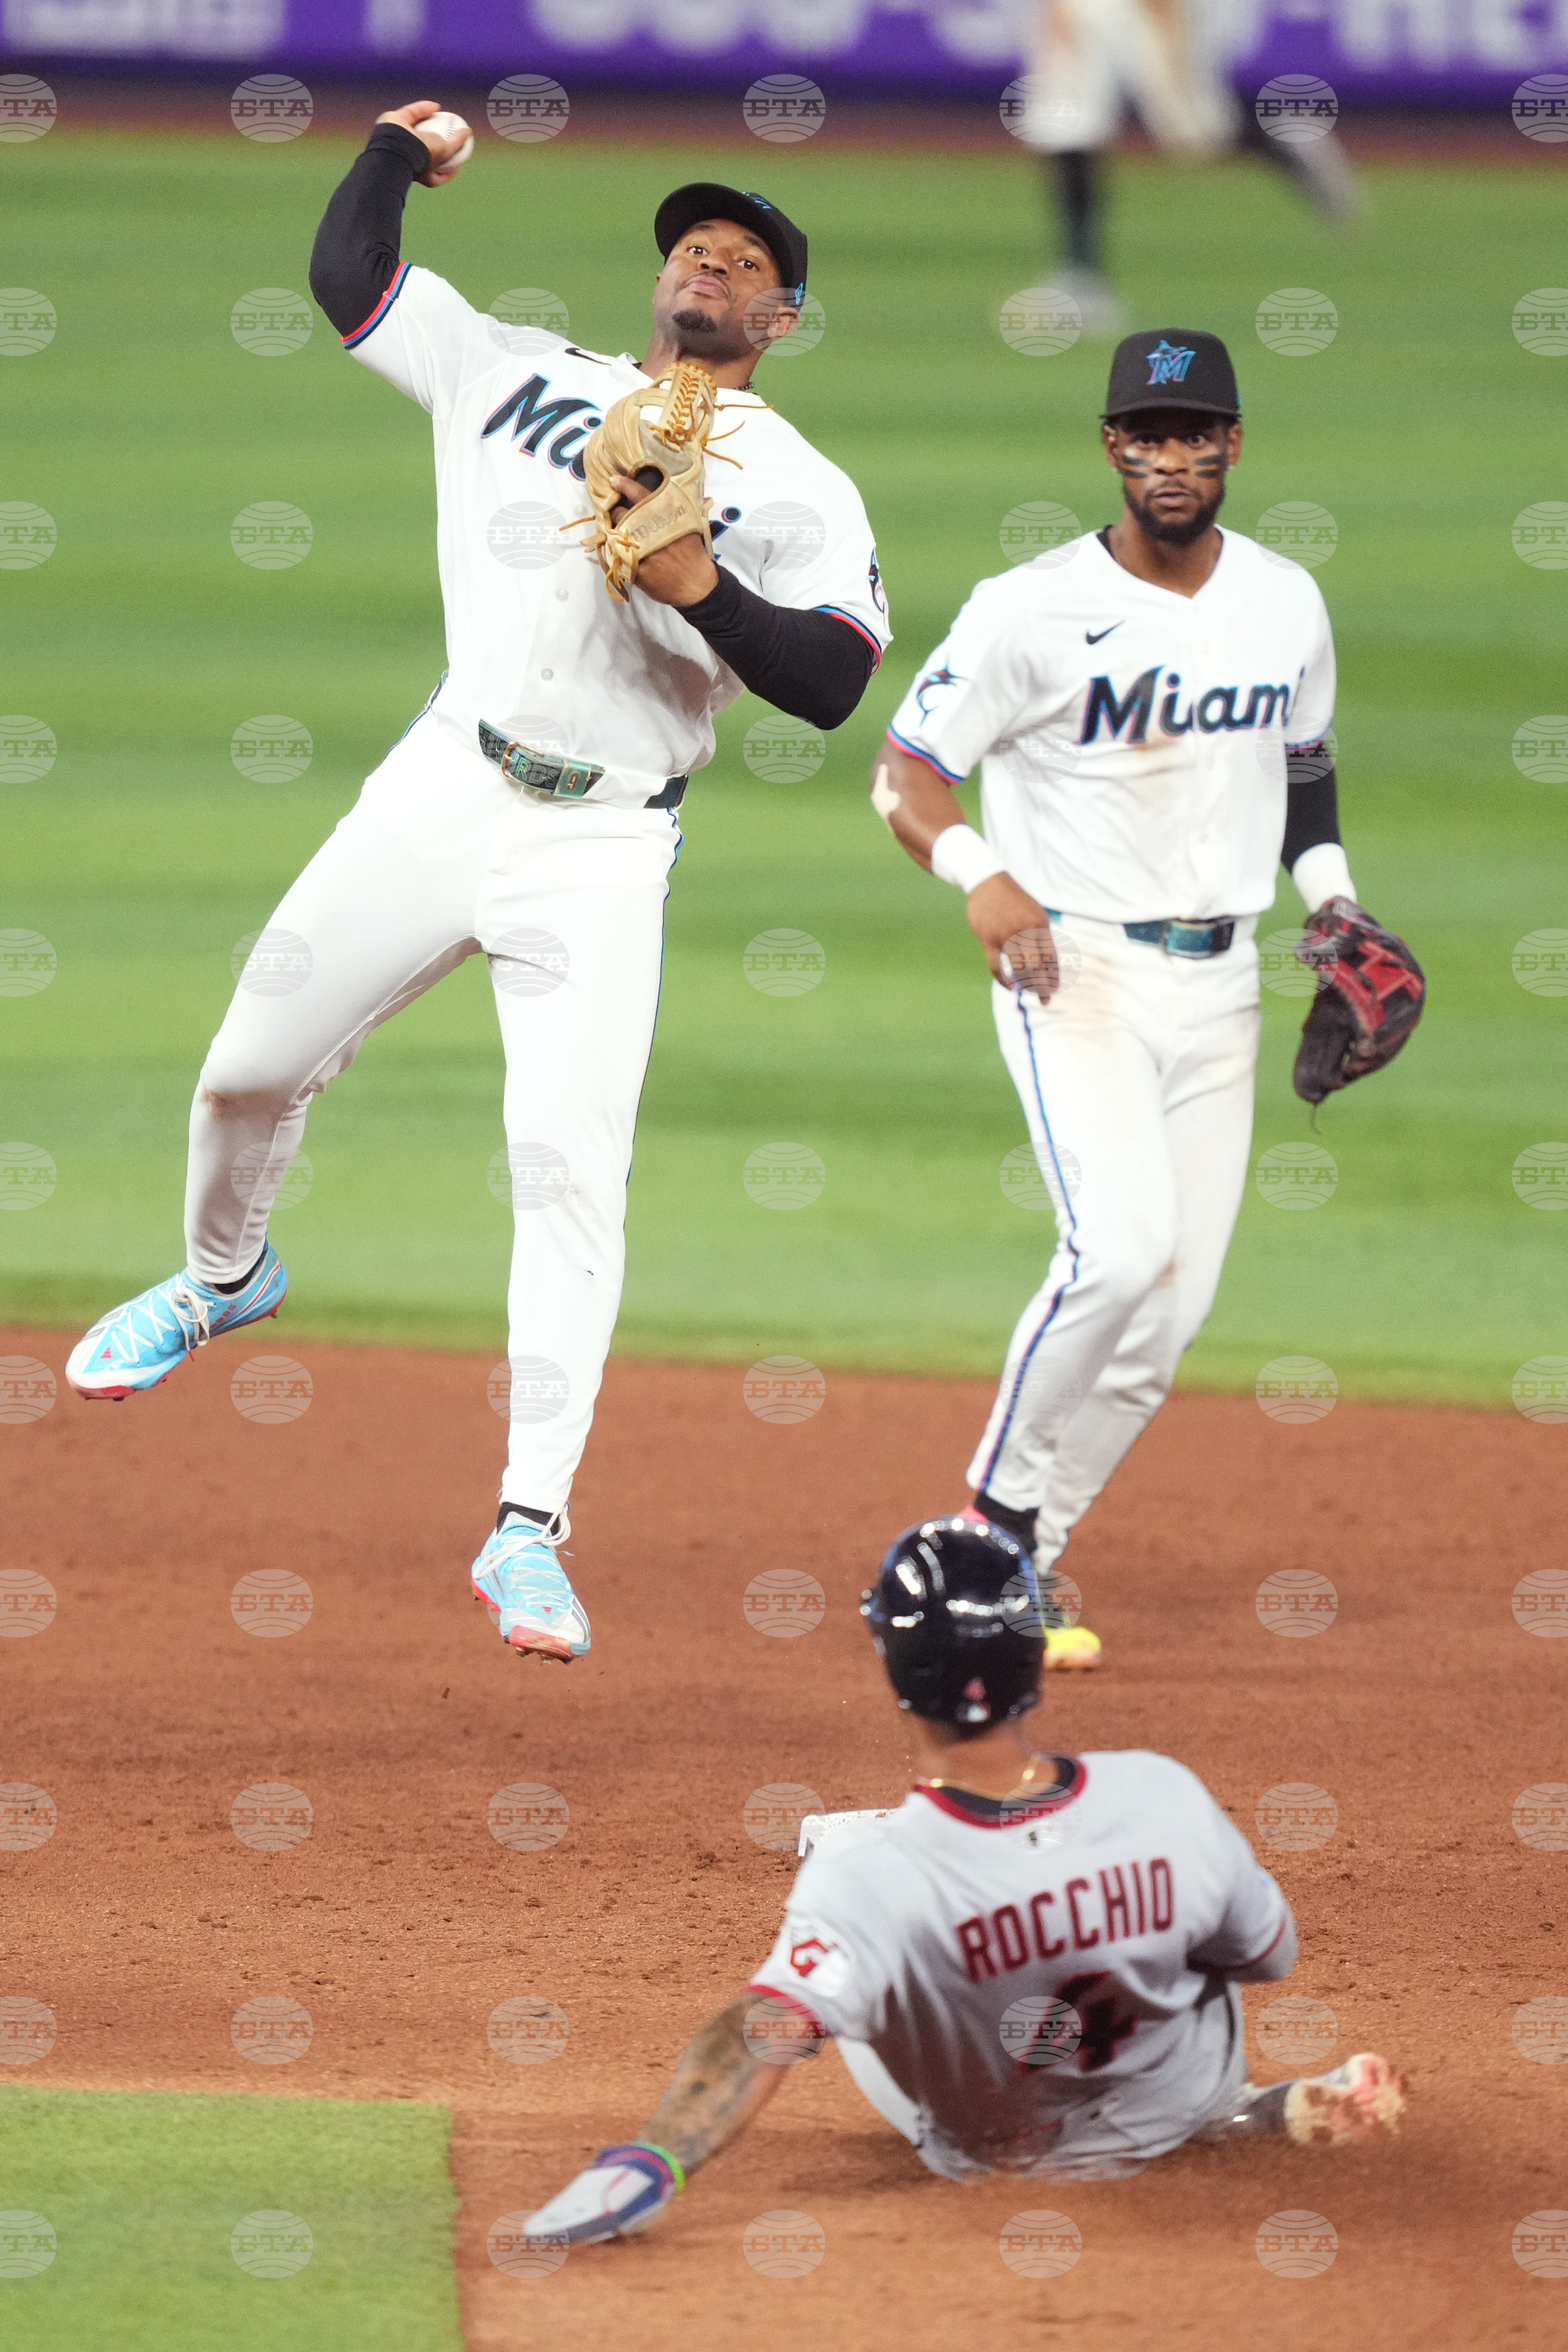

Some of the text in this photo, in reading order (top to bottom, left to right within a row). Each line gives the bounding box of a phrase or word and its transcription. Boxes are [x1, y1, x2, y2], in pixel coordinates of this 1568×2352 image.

[1073, 664, 1305, 745] Miam
[956, 1858, 1174, 1982] ROCCHIO
[1019, 1969, 1137, 2076] 4
